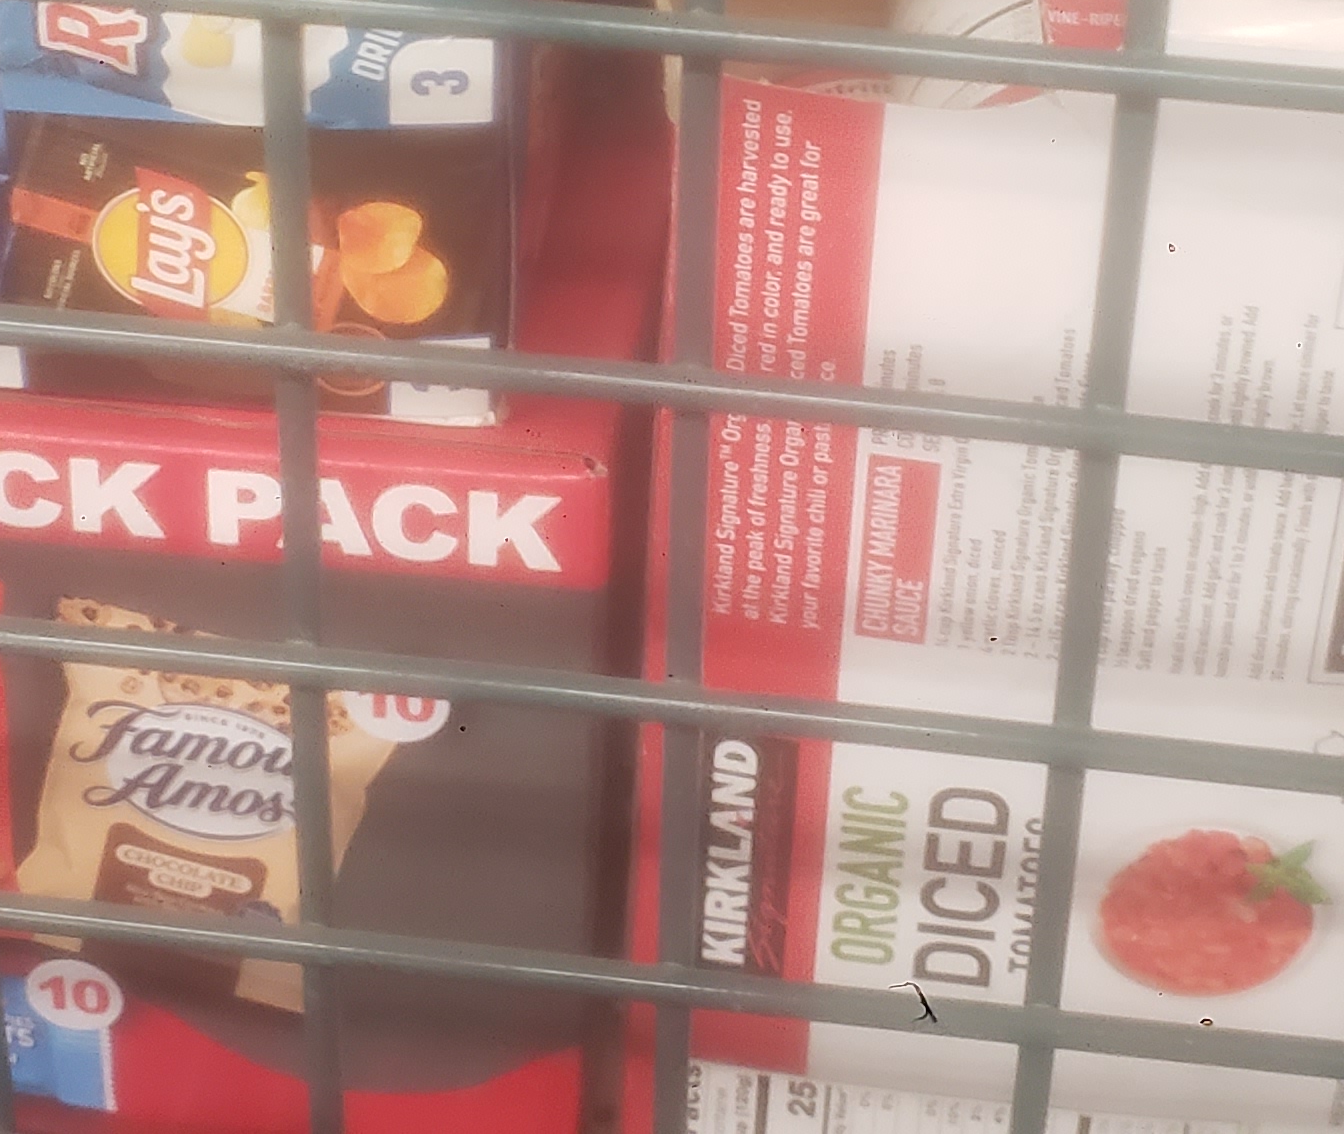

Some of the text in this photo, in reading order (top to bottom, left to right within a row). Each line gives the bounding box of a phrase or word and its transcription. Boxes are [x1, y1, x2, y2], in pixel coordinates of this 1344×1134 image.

[412, 70, 470, 97] 3
[773, 107, 793, 147] use.
[770, 151, 789, 170] to
[764, 173, 792, 226] ready
[130, 186, 217, 309] Lay's
[724, 98, 765, 371] Diced Tomatoes are harvested
[762, 229, 785, 265] and
[786, 138, 825, 379] ced Tomatoes are great for
[760, 321, 777, 338] in
[811, 465, 828, 485] or
[950, 446, 971, 481] Virgin
[773, 469, 804, 551] Signature
[805, 487, 826, 523] chili
[948, 481, 965, 510] Extra
[1016, 472, 1038, 517] Organic
[1039, 467, 1062, 523] Signature
[206, 468, 562, 573] PACK
[746, 507, 765, 526] of
[743, 530, 768, 571] peak
[800, 525, 825, 589] favorite
[860, 463, 903, 632] CHUNKY MARINARA
[966, 538, 981, 569] diced
[987, 528, 1005, 570] minced
[1011, 518, 1033, 572] Signature
[1033, 524, 1052, 572] Kirkland
[1150, 545, 1166, 574] taste
[709, 542, 736, 614] Kirkland
[741, 573, 761, 600] the
[767, 552, 792, 624] Kirkland
[1005, 573, 1023, 620] Kirkland
[1033, 574, 1046, 600] cans
[1122, 577, 1138, 606] dried
[1149, 574, 1162, 586] to
[799, 591, 823, 629] your
[891, 577, 922, 637] SAUCE
[1145, 588, 1162, 627] pepper
[1142, 627, 1155, 648] and
[69, 700, 294, 778] Famou
[81, 763, 296, 823] Amos
[123, 846, 248, 891] CHOCOLATE
[702, 739, 759, 966] KIRKLAND
[155, 870, 204, 893] CHIP
[831, 785, 910, 967] ORGANIC
[911, 786, 1010, 988] DICED
[38, 975, 112, 1016] 10
[787, 1078, 818, 1118] 25
